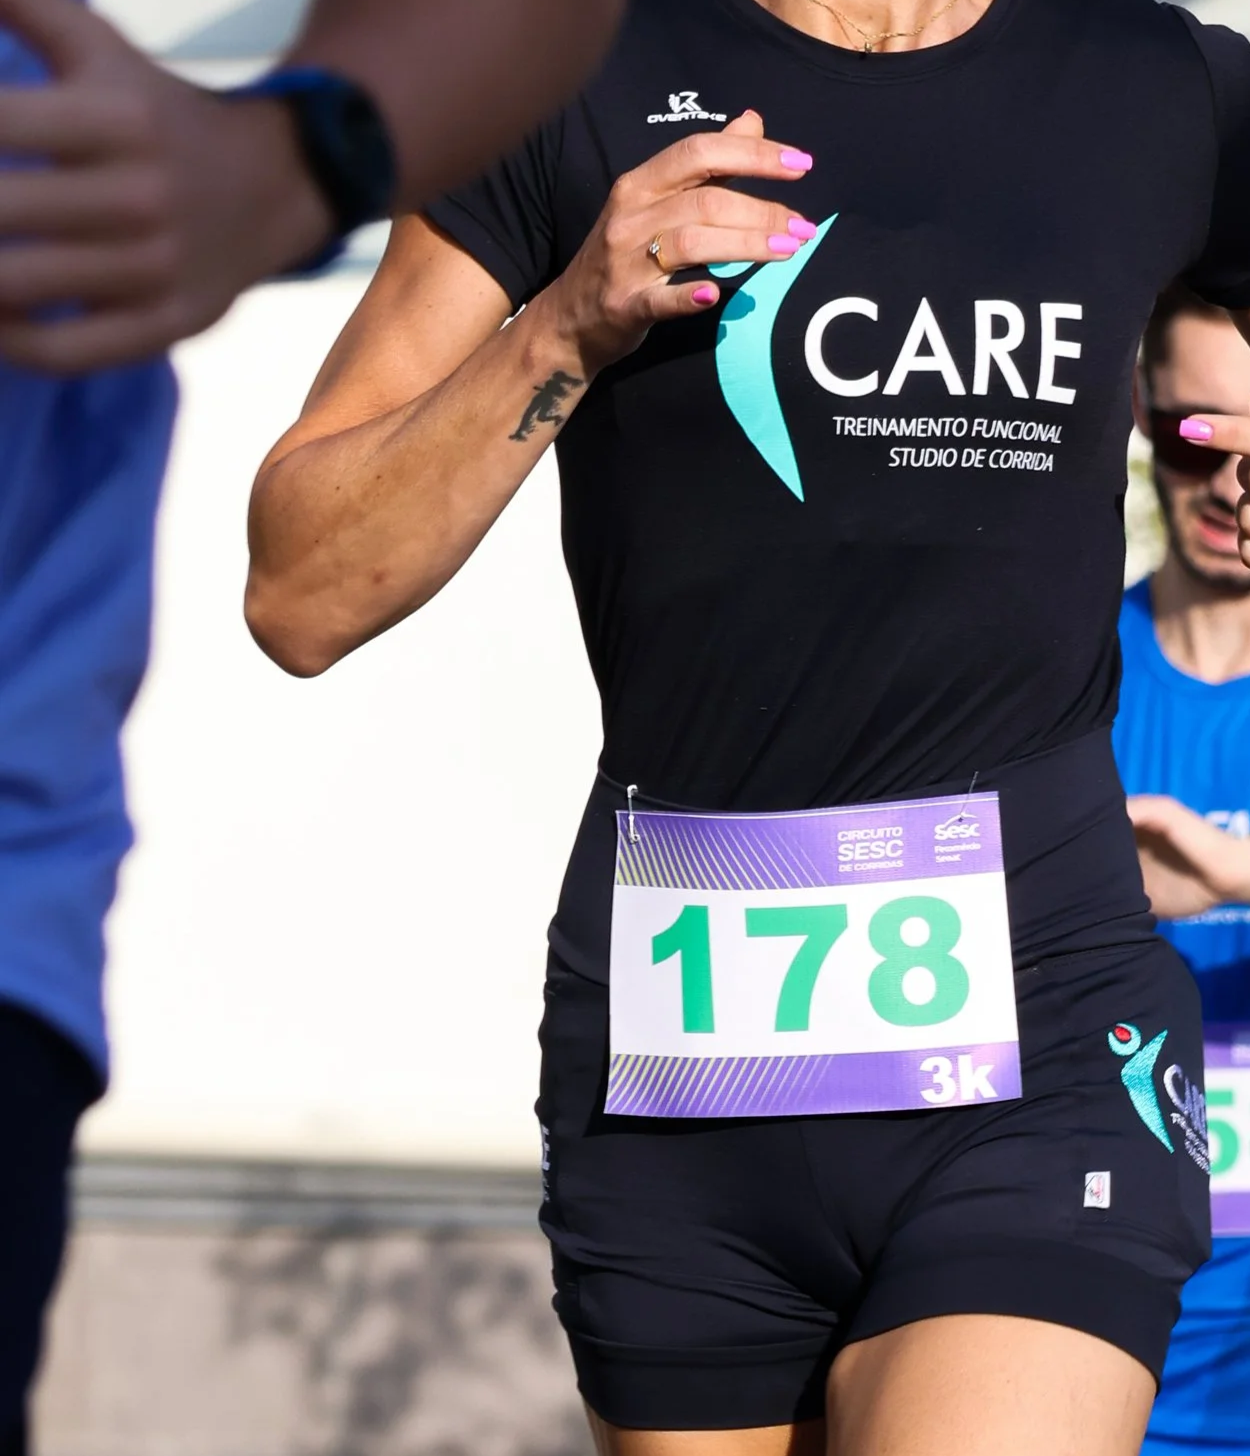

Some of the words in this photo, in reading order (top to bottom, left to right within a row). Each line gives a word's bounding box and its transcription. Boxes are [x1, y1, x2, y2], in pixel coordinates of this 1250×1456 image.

[804, 296, 1083, 405] CARE
[832, 416, 968, 438] TREINAMENTO
[971, 418, 1063, 444] FUNCIONAL
[888, 447, 958, 468] STUDIO
[960, 448, 987, 468] DE
[988, 449, 1054, 472] CORRIDA
[837, 826, 903, 842] CIRCUITO
[837, 839, 904, 861] SESC
[838, 863, 853, 872] DE
[854, 860, 904, 871] CORRIDAS
[651, 895, 970, 1033] 178
[918, 1054, 997, 1103] 3k
